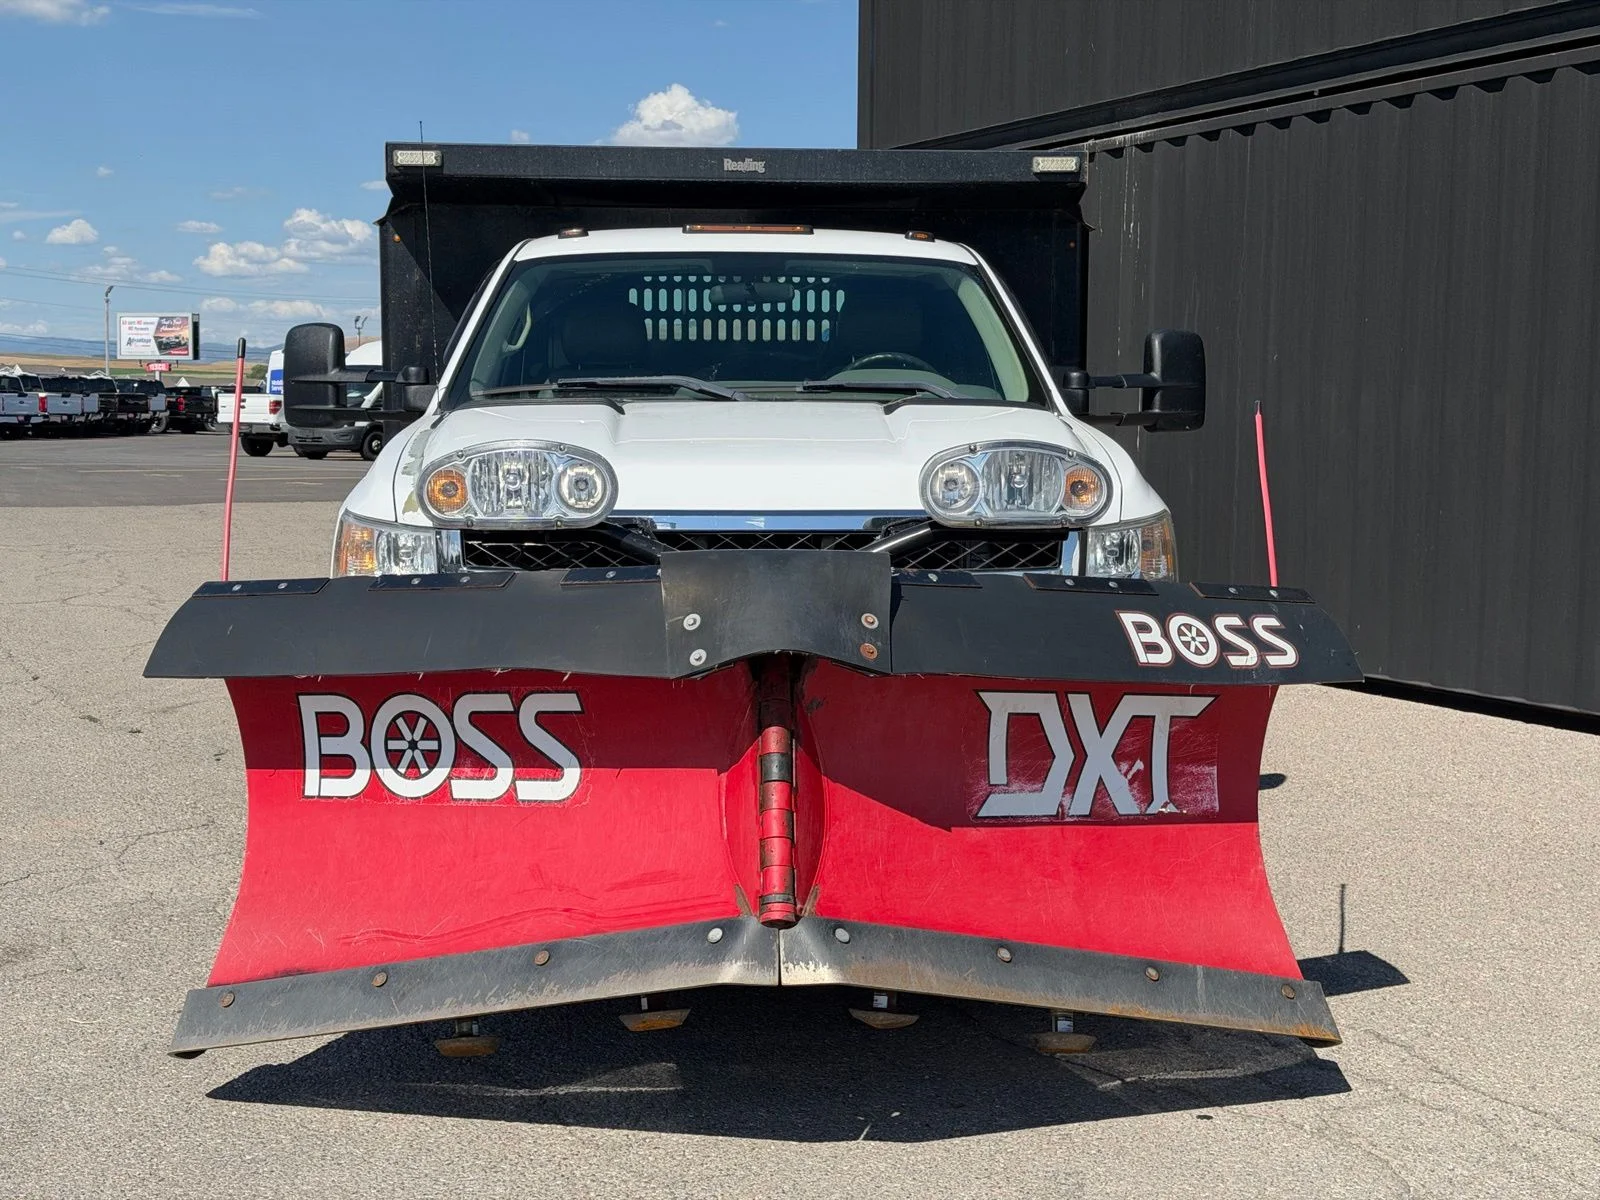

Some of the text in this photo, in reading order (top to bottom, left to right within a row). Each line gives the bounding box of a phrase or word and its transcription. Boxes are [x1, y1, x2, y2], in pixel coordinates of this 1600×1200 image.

[723, 157, 766, 174] Reading
[1115, 611, 1299, 667] BOSS
[297, 692, 584, 801] BOSS
[974, 690, 1218, 817] DXT
